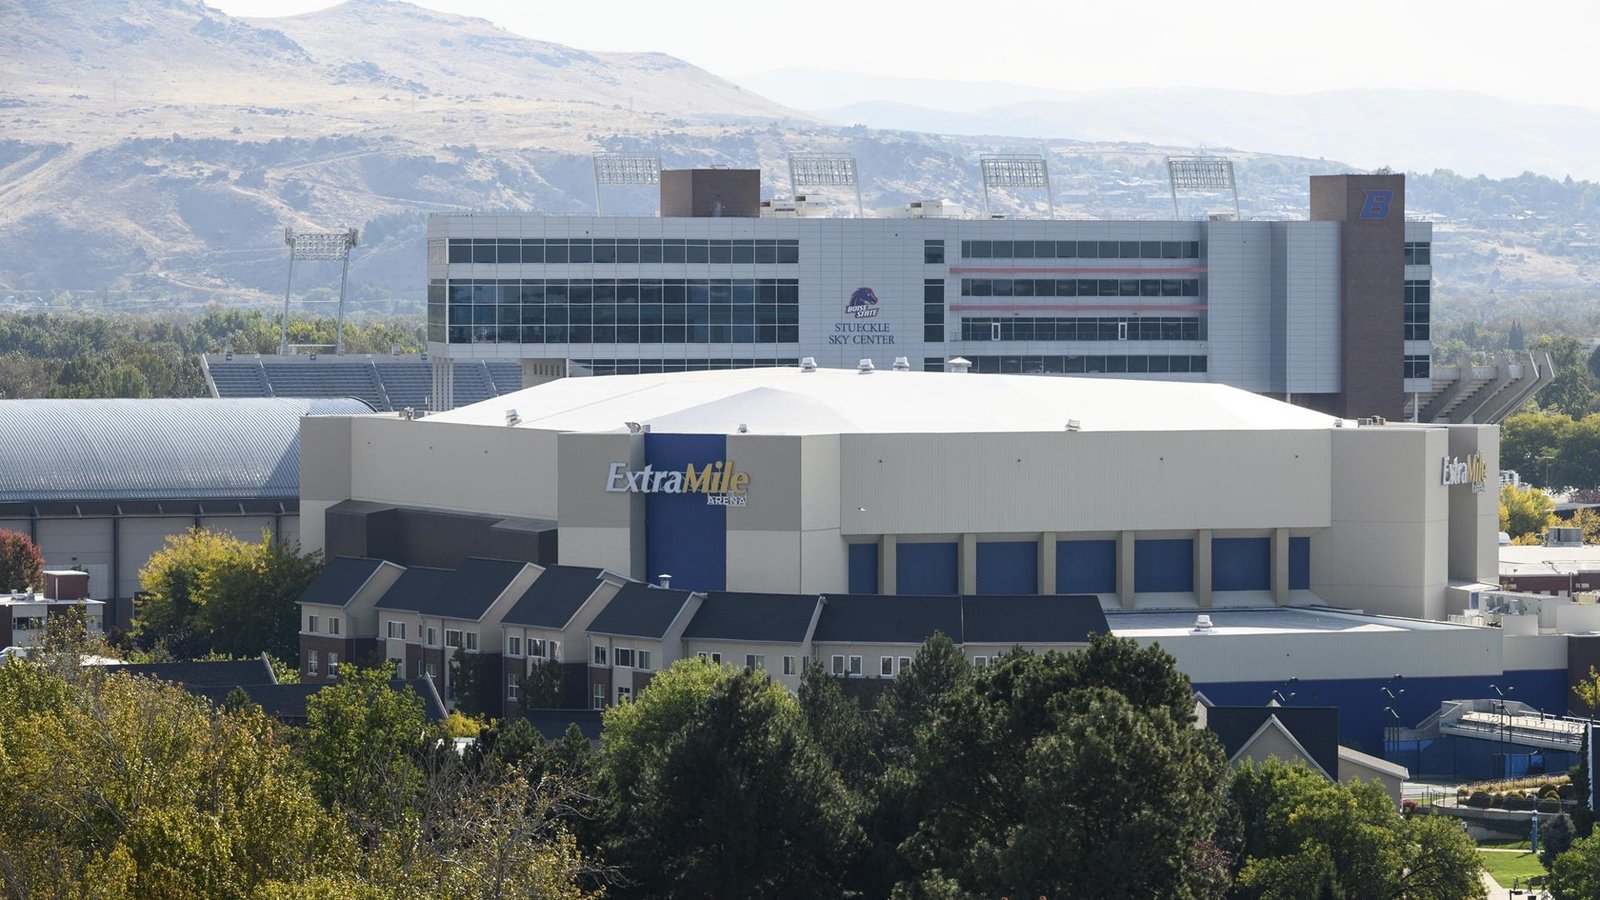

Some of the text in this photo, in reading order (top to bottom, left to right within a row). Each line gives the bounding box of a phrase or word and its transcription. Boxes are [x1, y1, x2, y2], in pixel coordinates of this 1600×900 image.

[1359, 189, 1393, 220] B
[847, 305, 868, 313] BOISE
[856, 309, 878, 318] STATE
[834, 323, 890, 333] STUECKLE
[828, 335, 895, 345] SKY CENTER
[606, 460, 750, 493] ExtraMile
[706, 495, 746, 506] ARENA
